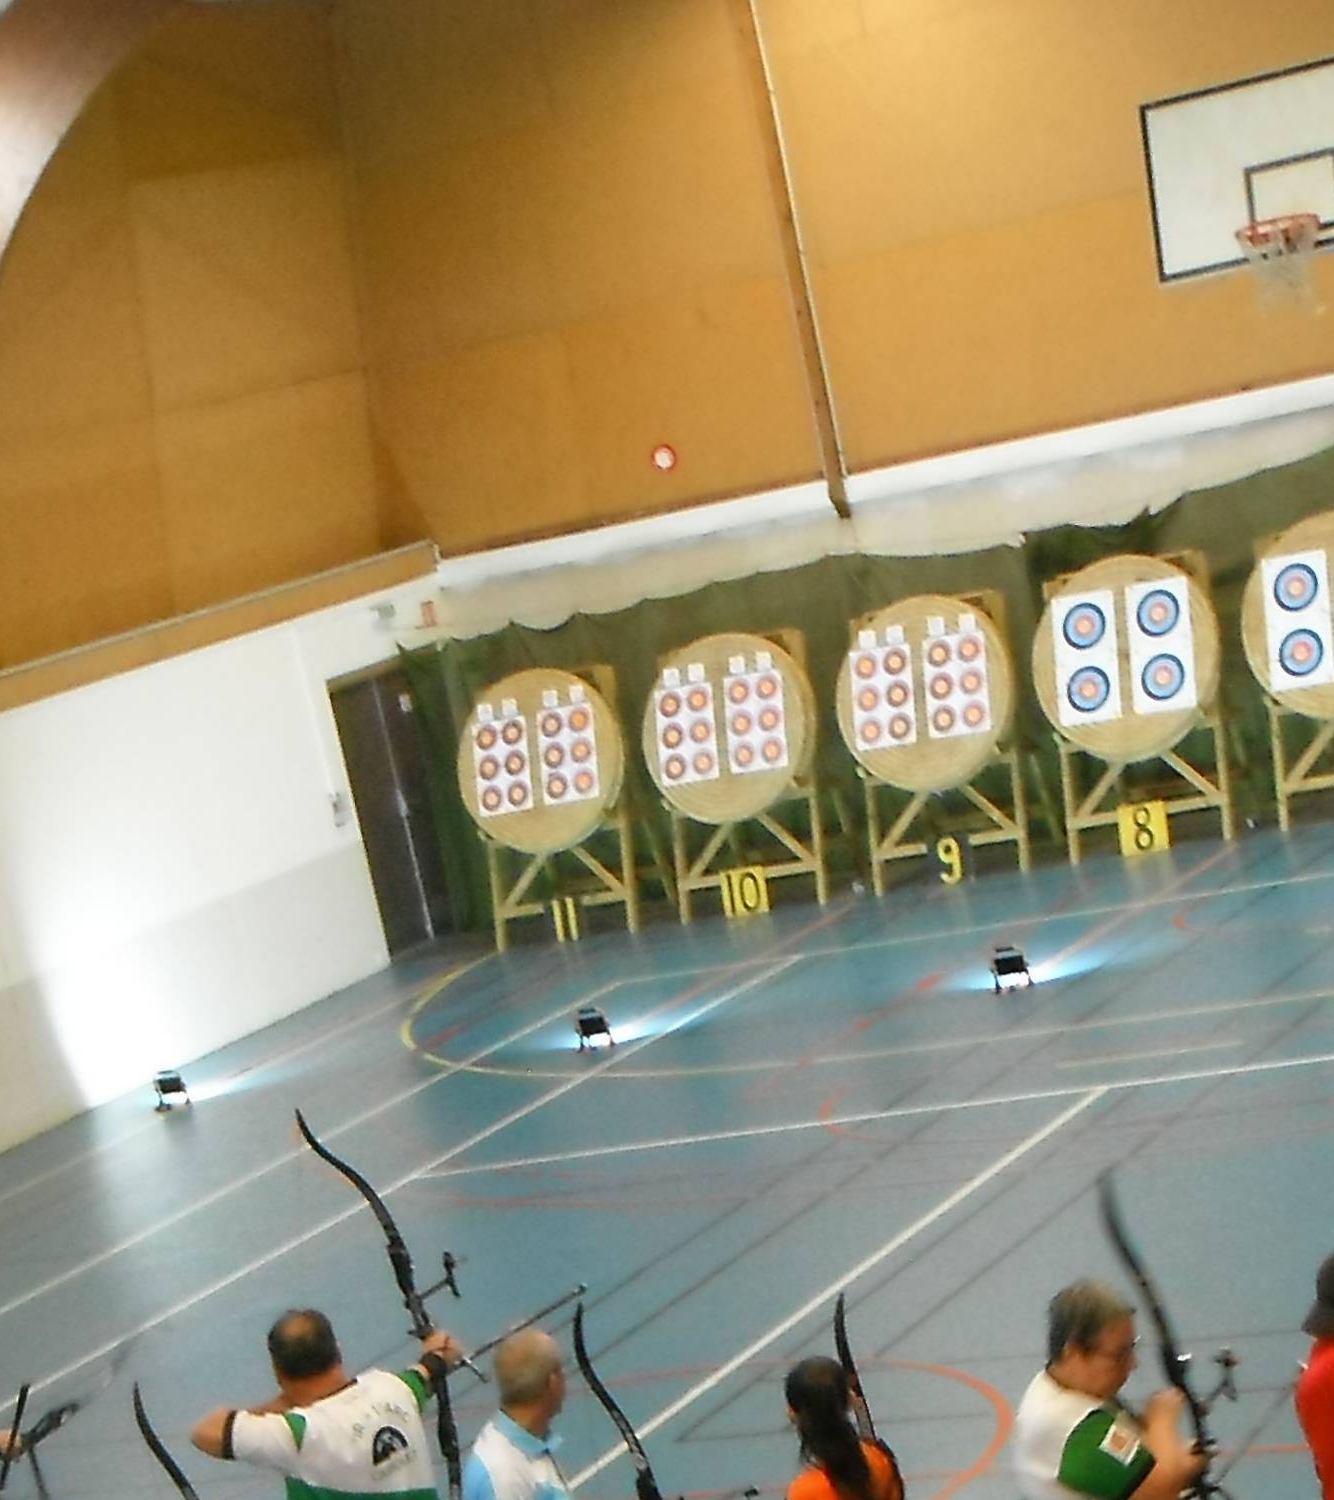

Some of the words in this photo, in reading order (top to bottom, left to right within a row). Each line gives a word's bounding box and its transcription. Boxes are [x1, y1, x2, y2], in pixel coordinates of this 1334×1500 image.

[1133, 806, 1154, 851] 8
[937, 835, 963, 885] 9
[726, 871, 762, 916] 10
[551, 897, 578, 943] 11
